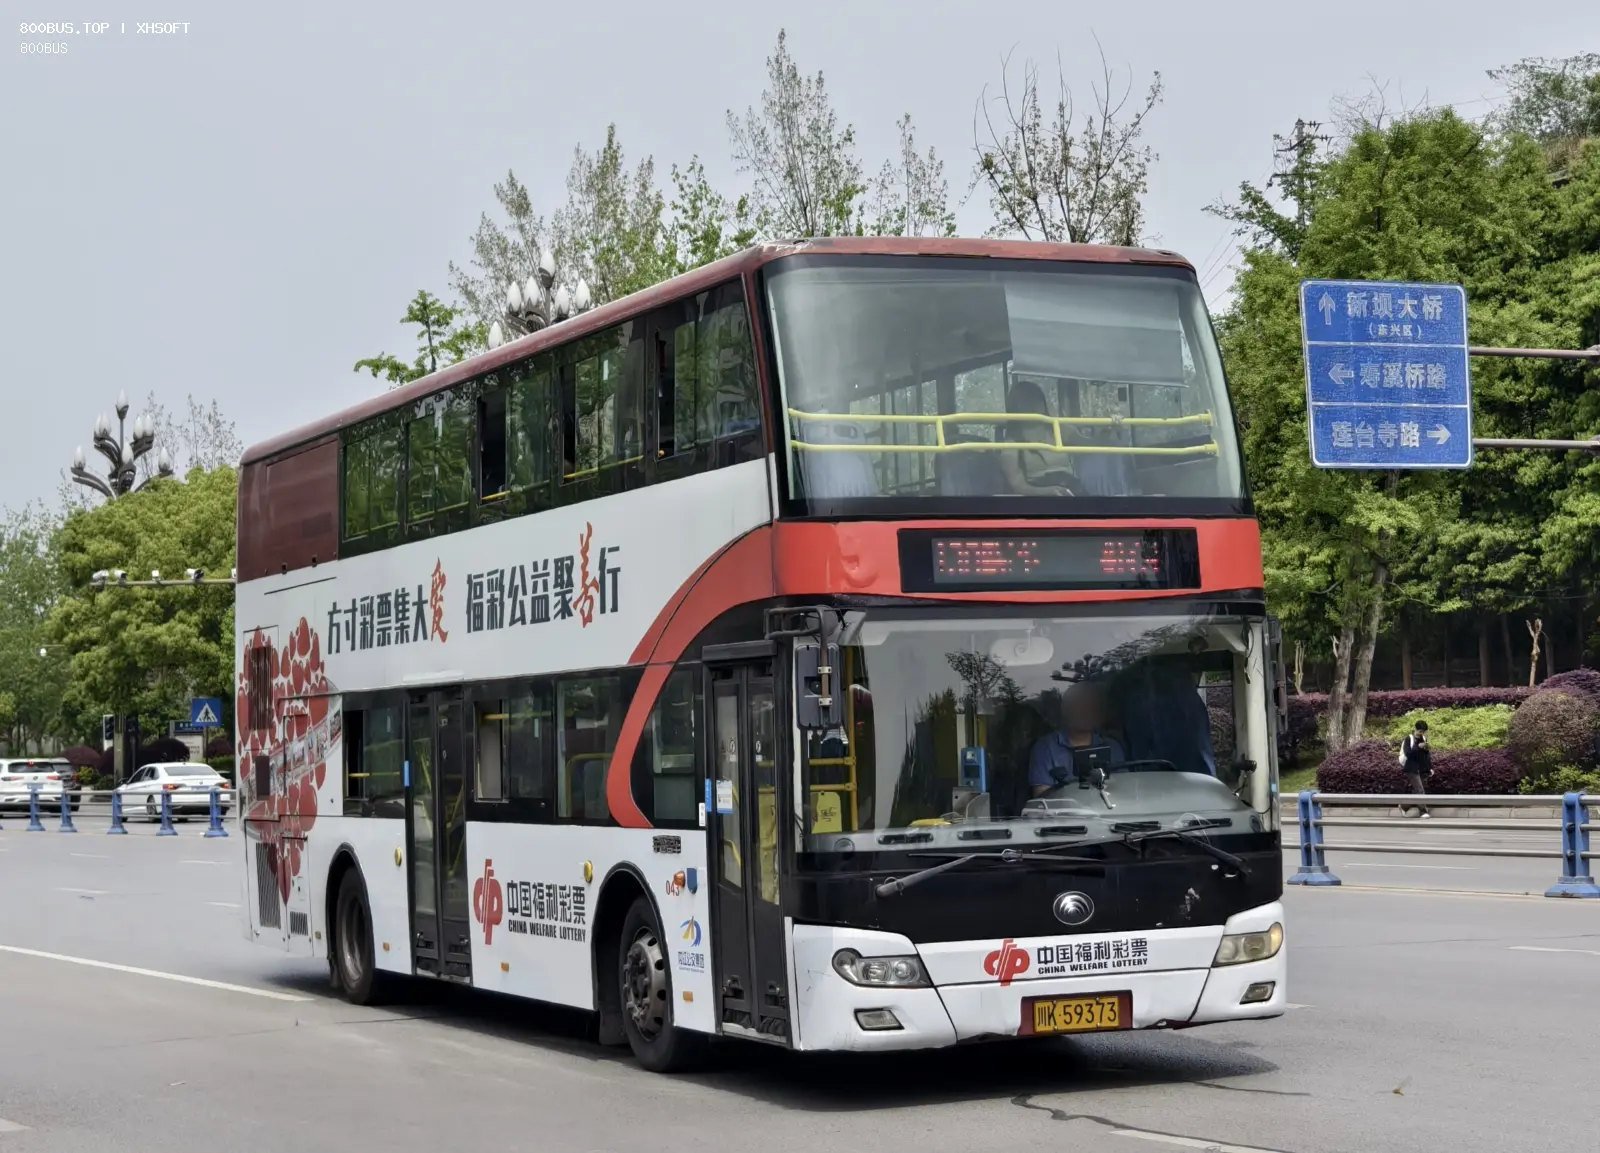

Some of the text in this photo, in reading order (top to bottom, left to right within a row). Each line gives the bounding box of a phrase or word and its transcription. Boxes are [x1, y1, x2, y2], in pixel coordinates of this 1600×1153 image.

[1346, 291, 1443, 320] 新坝大桥
[507, 880, 586, 925] 中国福利彩票
[508, 919, 586, 943] CHINA WELFARE LOTTERY
[1037, 937, 1148, 965] 中国福利彩票
[1038, 958, 1148, 975] CHINA WELFARE LOTTERY
